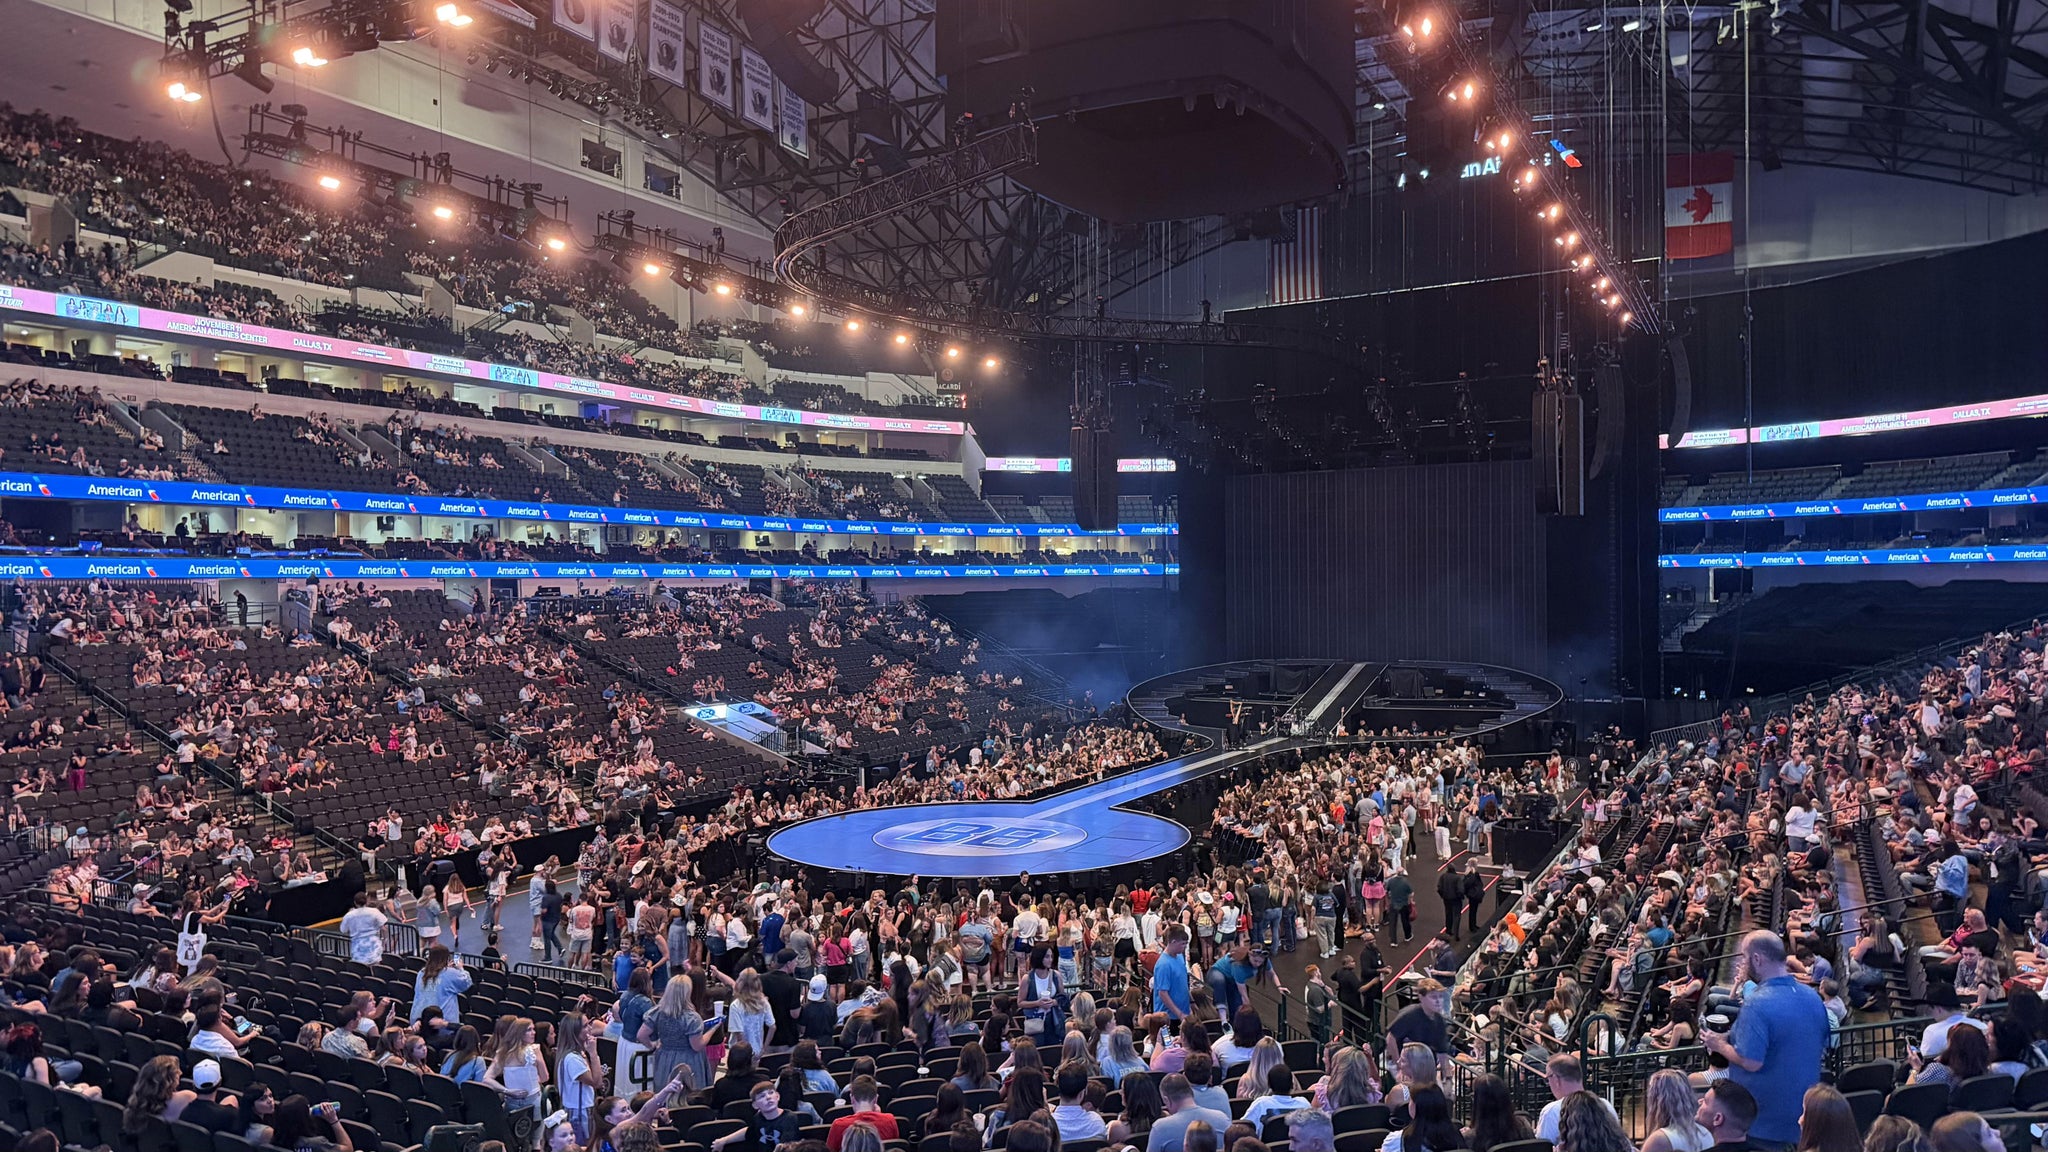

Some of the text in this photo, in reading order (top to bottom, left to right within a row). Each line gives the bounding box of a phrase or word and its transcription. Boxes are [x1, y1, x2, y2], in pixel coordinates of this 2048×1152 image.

[195, 318, 234, 331] NOVEMBER
[166, 321, 267, 344] AMERICAN AIRLINES CENTER
[293, 338, 333, 352] DALLAS, TX
[1952, 407, 1991, 420] DALLAS, TX
[1864, 414, 1901, 425] NOVEMBER
[1841, 417, 1931, 433] AMERICAN AIRLINES CENTER
[0, 480, 32, 492] rican
[88, 485, 142, 497] American
[192, 490, 240, 501] American
[284, 495, 326, 505] American
[1993, 493, 2027, 502] American
[366, 499, 404, 509] American
[1863, 501, 1896, 511] American
[1927, 498, 1960, 507] American
[440, 503, 475, 513] American
[508, 507, 539, 516] American
[1796, 505, 1829, 514] American
[569, 511, 598, 519] American
[1666, 511, 1699, 519] American
[1732, 509, 1764, 517] American
[625, 514, 651, 522] American
[1825, 555, 1858, 563] American
[1888, 553, 1919, 562] American
[1950, 552, 1983, 561] American
[2014, 550, 2046, 559] American
[1700, 557, 1732, 565] American
[1762, 556, 1793, 564] American
[88, 564, 140, 575] American
[189, 564, 235, 575] American
[278, 565, 320, 575] American
[358, 565, 396, 575] American
[431, 566, 465, 575] American
[497, 566, 529, 575] American
[558, 567, 586, 575] American
[613, 567, 639, 575] American
[895, 821, 1060, 849] BB
